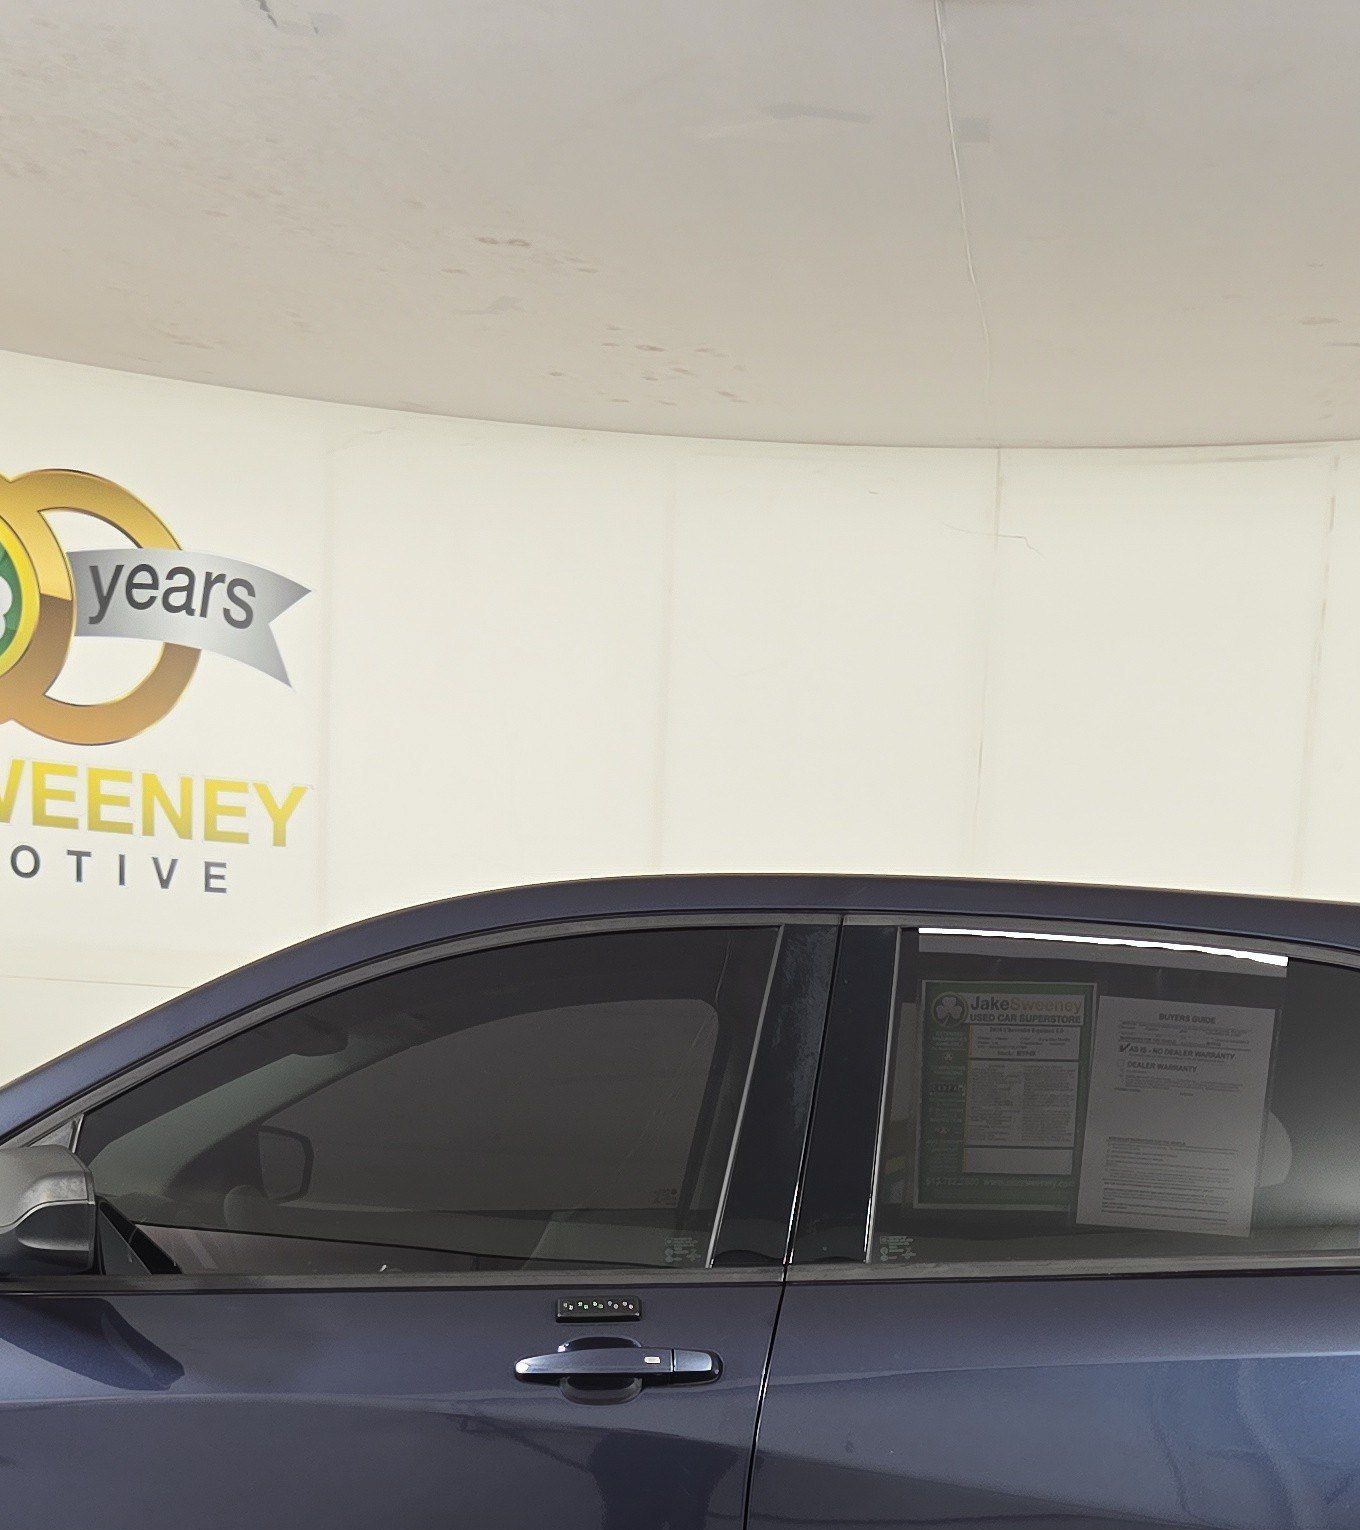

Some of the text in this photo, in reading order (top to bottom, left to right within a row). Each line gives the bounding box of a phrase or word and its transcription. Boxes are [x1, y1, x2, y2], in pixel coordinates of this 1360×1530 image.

[87, 557, 257, 630] years
[970, 1013, 1082, 1024] USED CAR SUPERSTORE
[1159, 1013, 1217, 1024] BUYERS GUIDE
